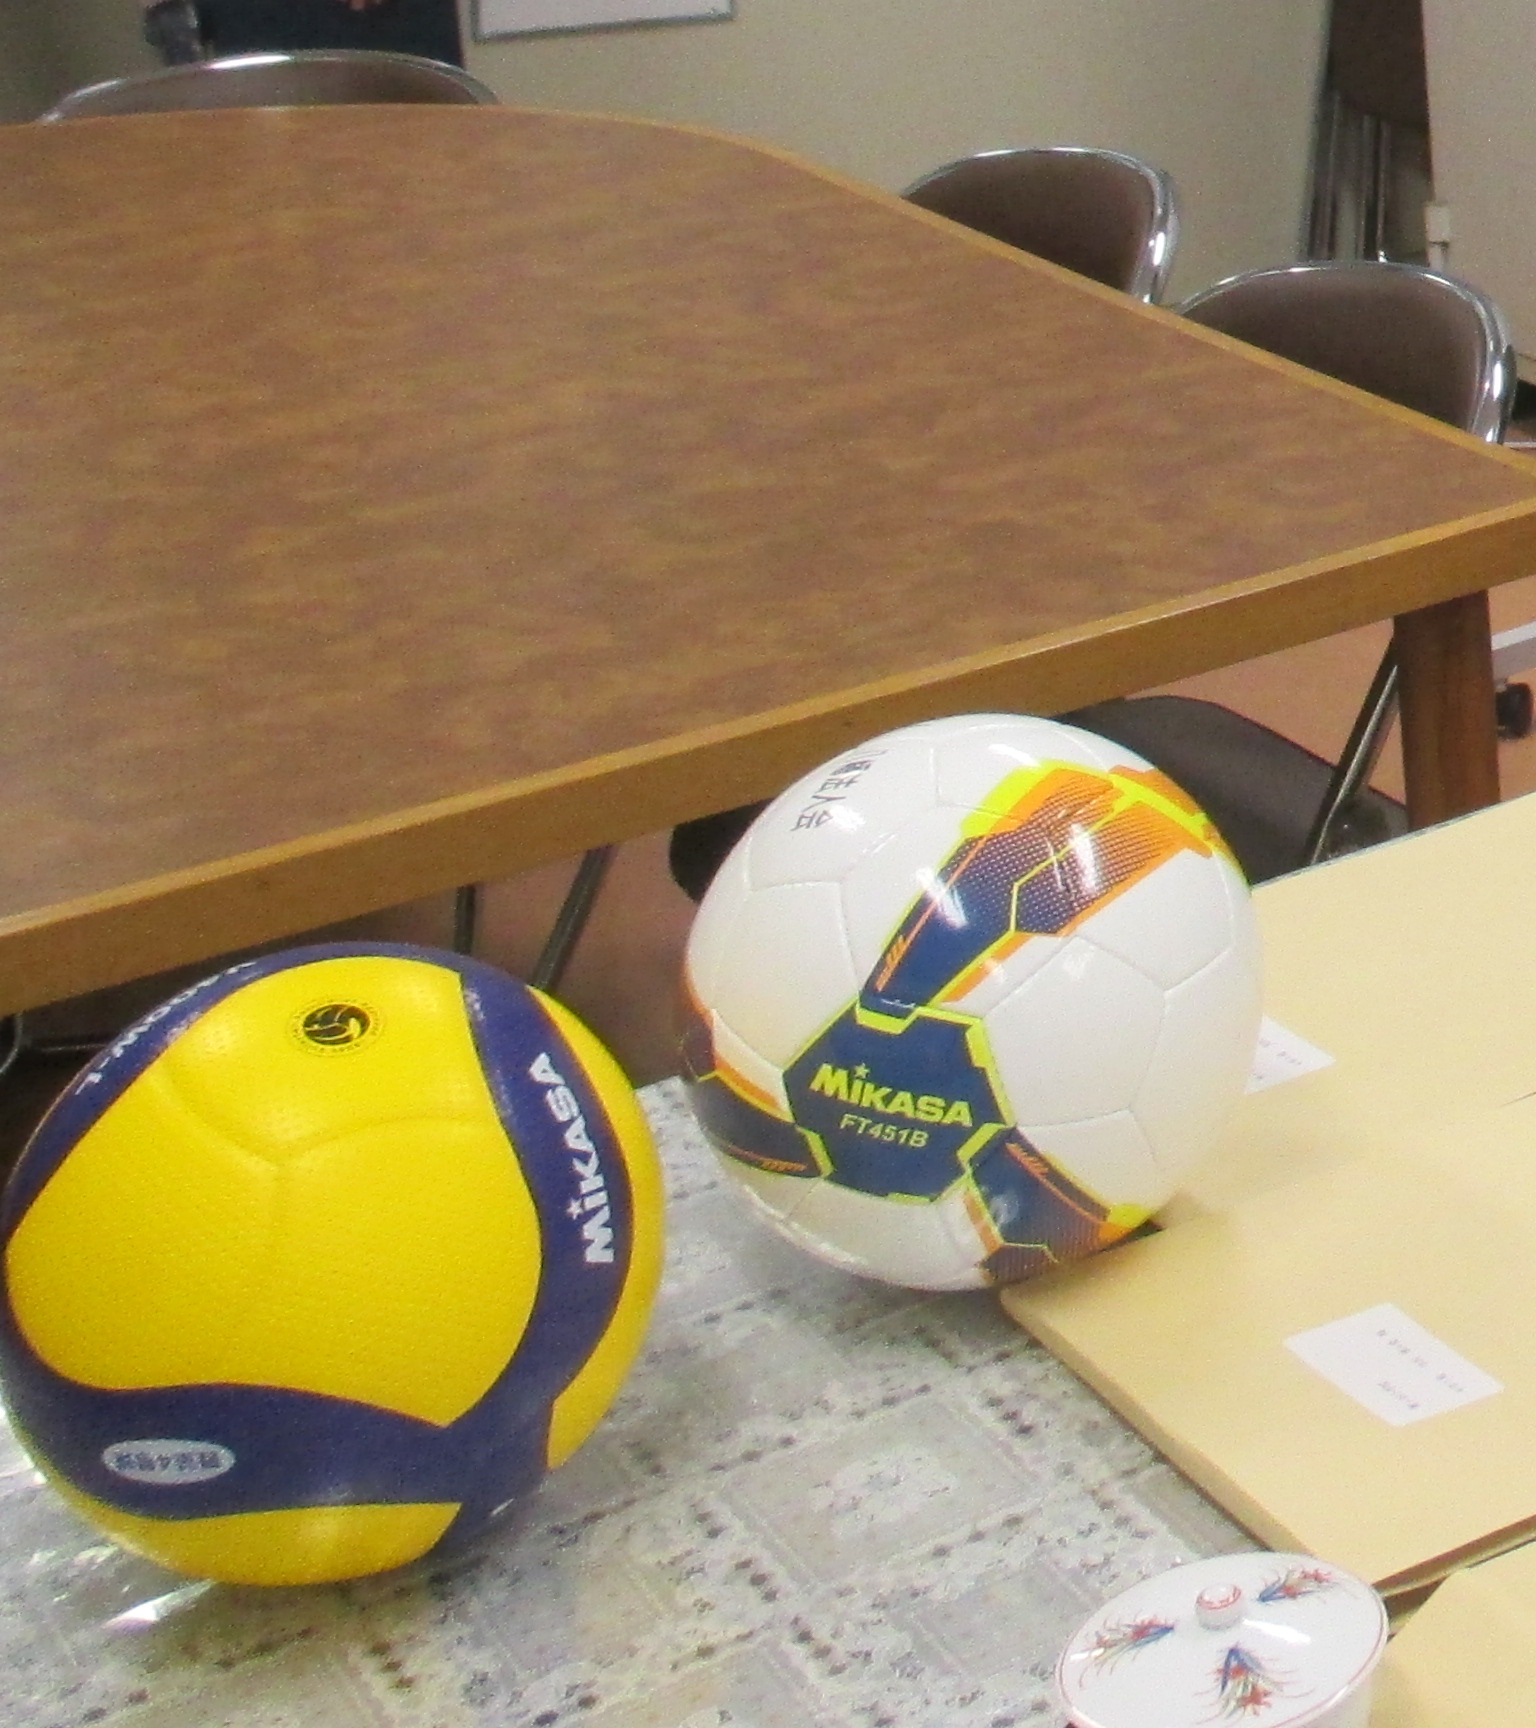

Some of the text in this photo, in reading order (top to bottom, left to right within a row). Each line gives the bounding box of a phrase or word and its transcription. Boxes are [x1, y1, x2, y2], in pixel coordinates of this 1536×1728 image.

[809, 1062, 973, 1128] MIKASA
[528, 1052, 615, 1263] MIKASA
[839, 1113, 930, 1148] FT451B
